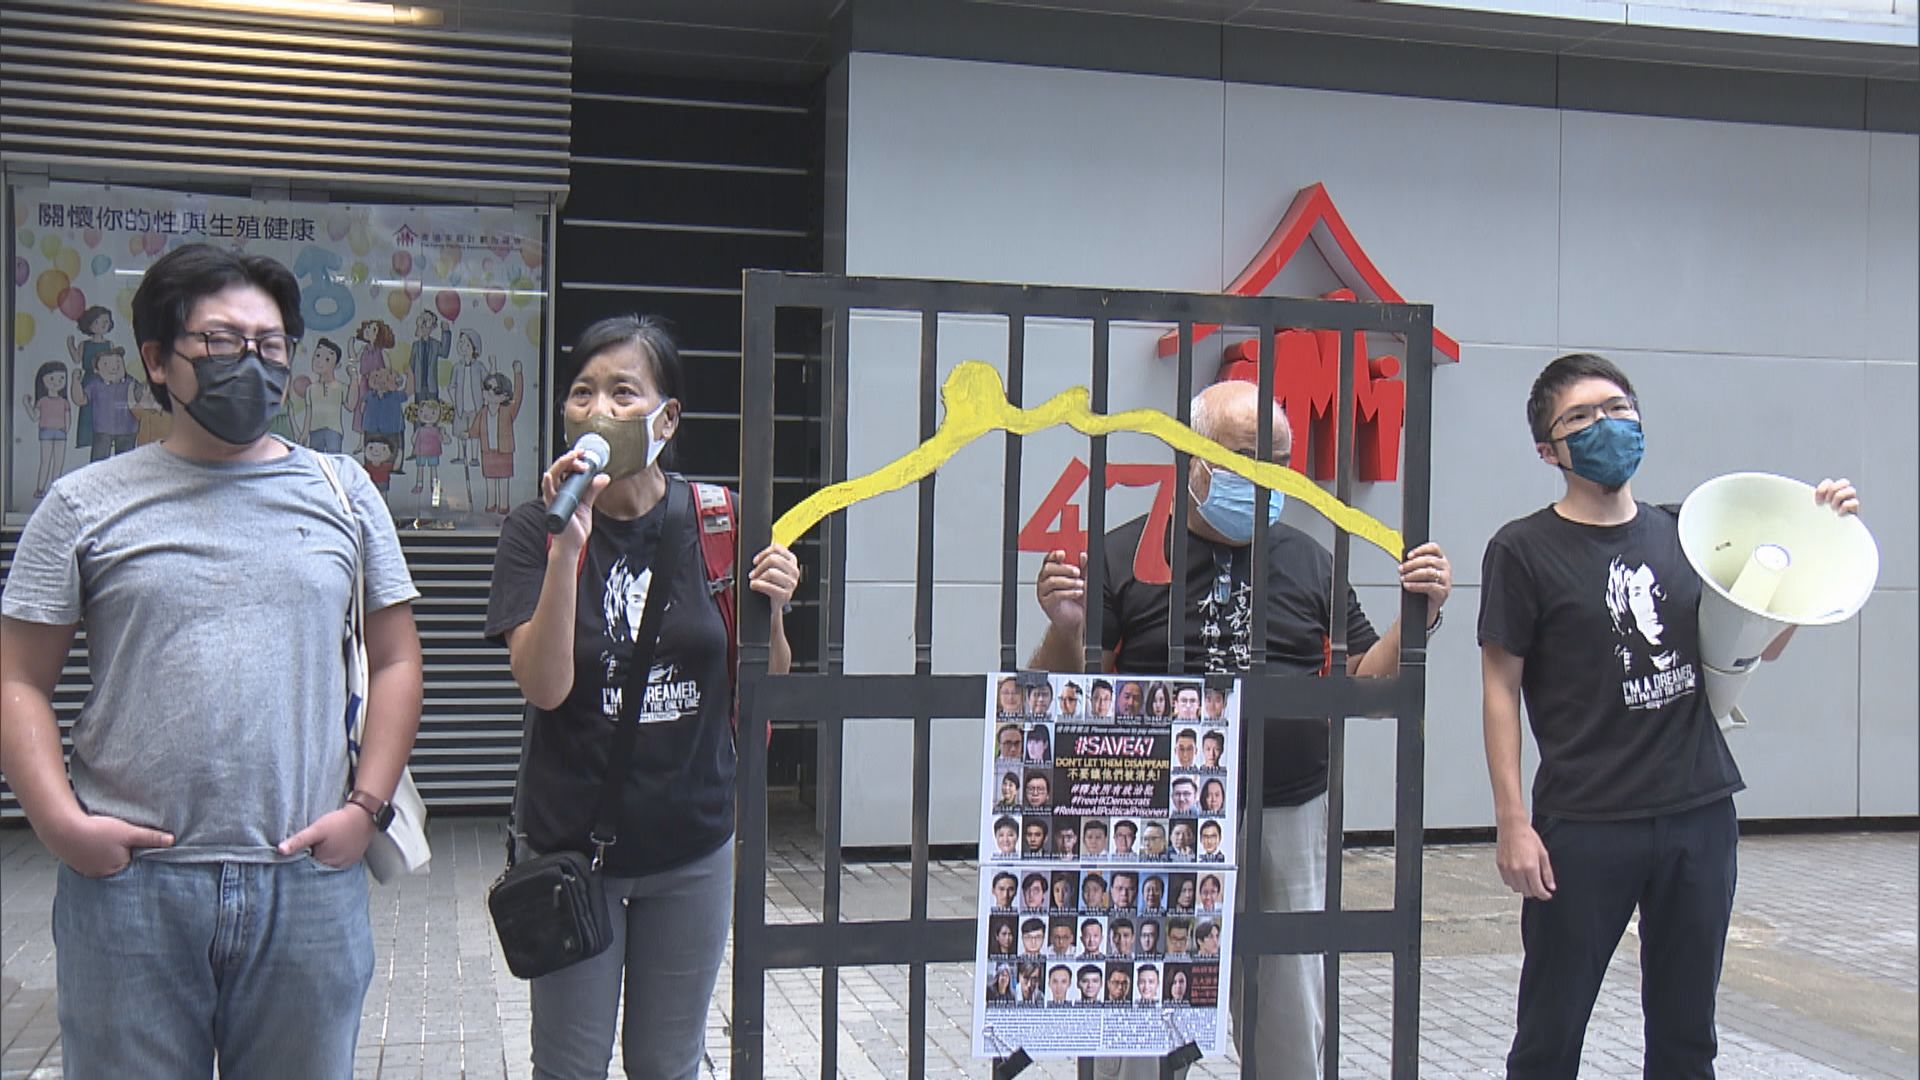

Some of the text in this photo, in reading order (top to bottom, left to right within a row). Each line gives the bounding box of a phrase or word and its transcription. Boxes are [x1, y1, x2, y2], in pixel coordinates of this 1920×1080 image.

[38, 202, 316, 242] 關懷你的性與生殖健康
[1018, 456, 1177, 586] 47
[1622, 663, 1696, 697] I'M A DREAMER,
[602, 680, 701, 704] I'M REAMER,
[602, 703, 618, 716] BUT
[650, 702, 663, 712] THE
[665, 699, 683, 711] ONLY
[1074, 735, 1155, 757] #SAVE47
[1055, 757, 1082, 767] DON'T
[1083, 758, 1100, 767] LET
[1100, 758, 1123, 768] THEM
[1053, 805, 1169, 817] #ReleaseAllPoliticalPrisoners
[1070, 795, 1151, 806] #FreeHKDemocrats
